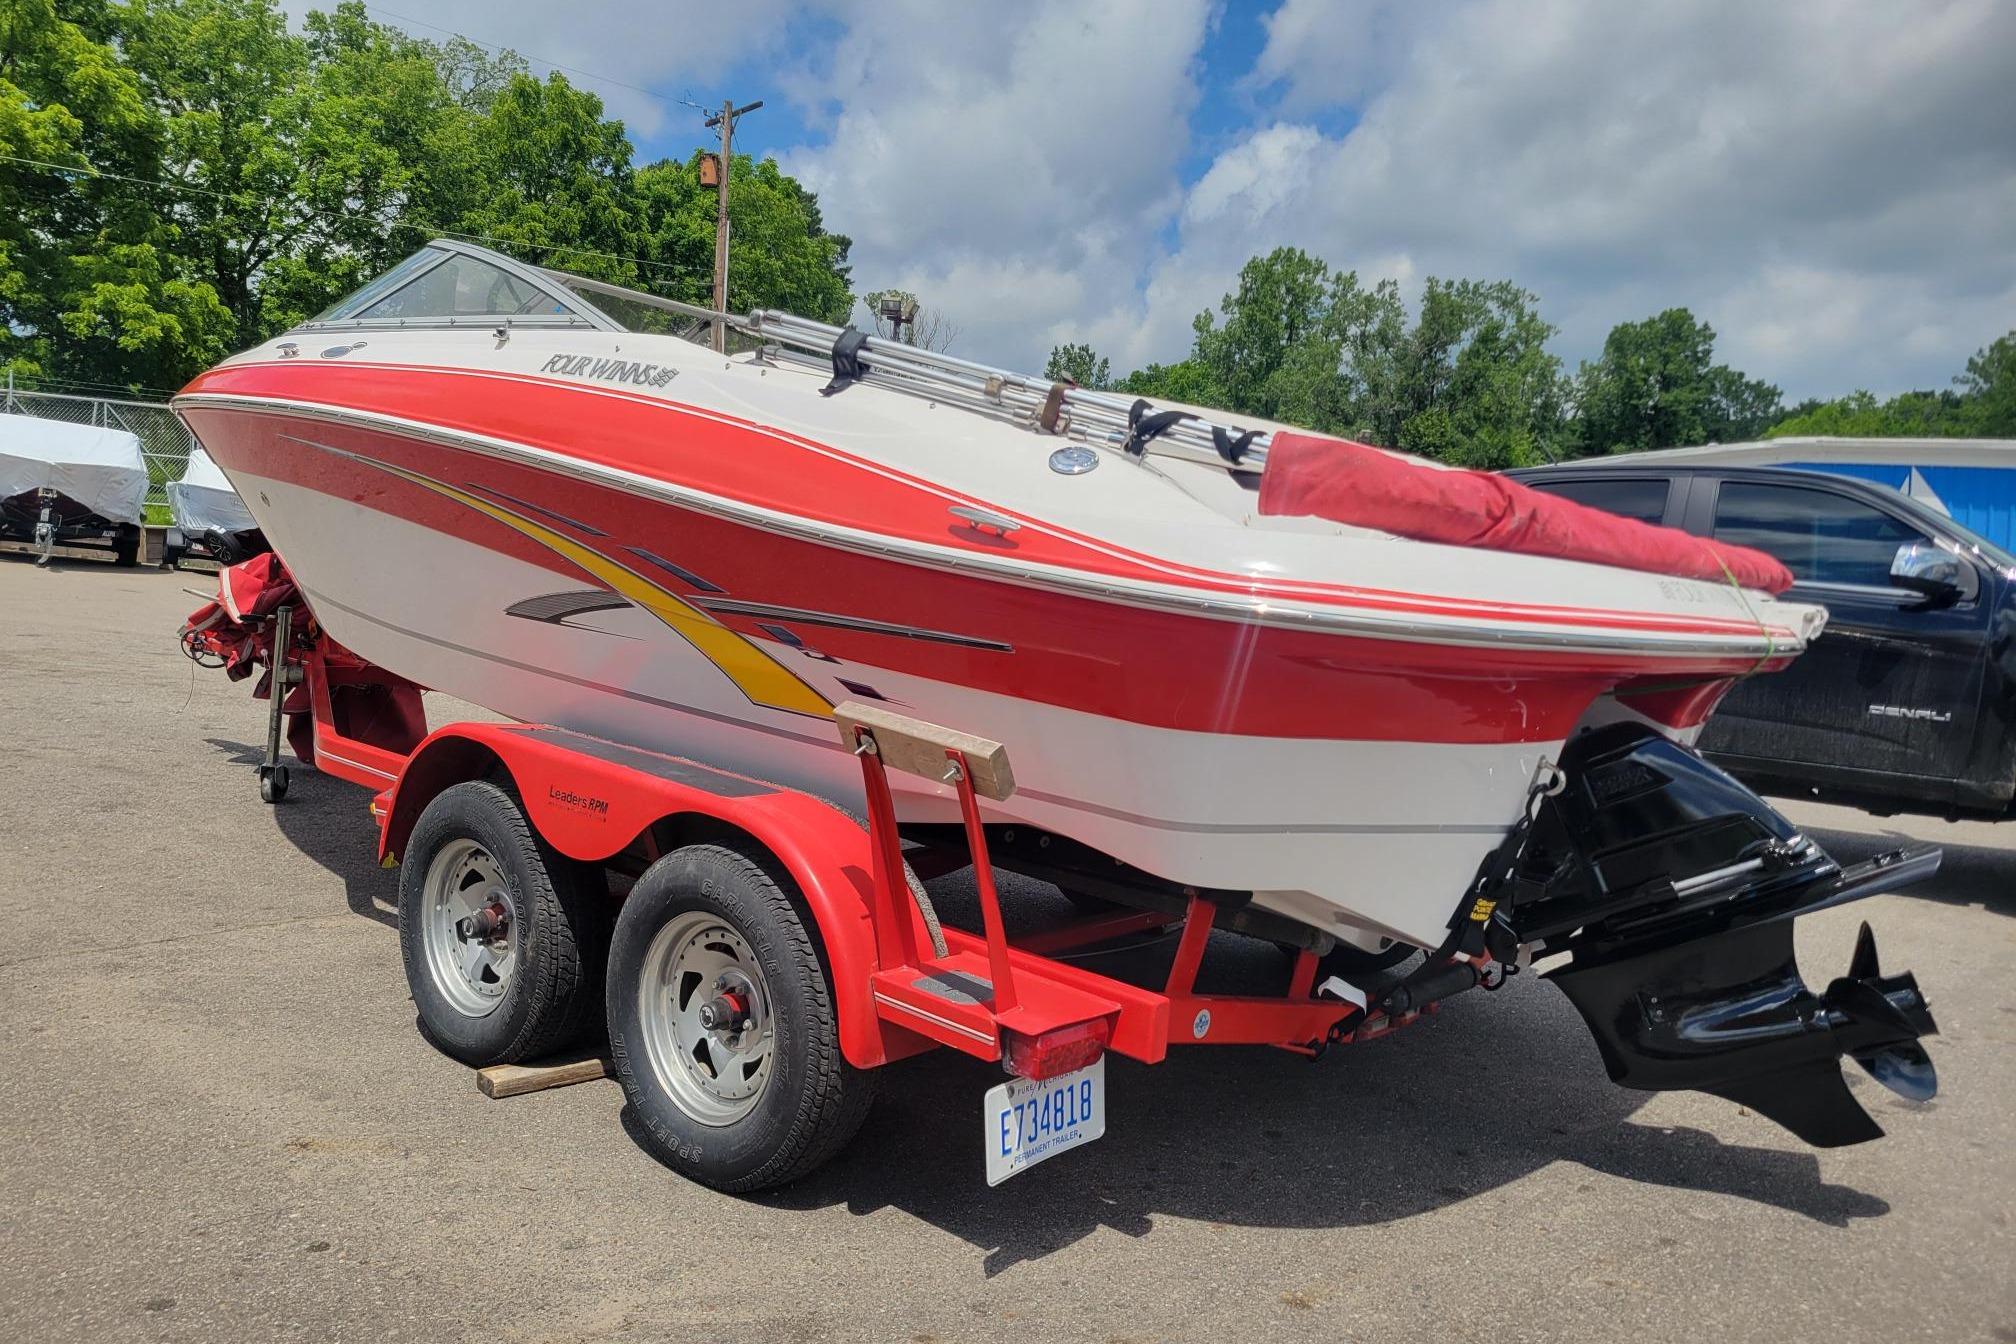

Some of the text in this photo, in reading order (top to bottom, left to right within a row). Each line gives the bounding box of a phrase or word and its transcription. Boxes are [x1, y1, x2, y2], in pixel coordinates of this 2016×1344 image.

[540, 353, 659, 385] FOUR WINNS
[1868, 704, 1952, 721] DENALI
[549, 783, 588, 809] Leaders
[588, 798, 609, 815] RPM
[700, 878, 782, 978] CARLISLE
[613, 1031, 703, 1164] SPORT TRAIL
[1000, 1079, 1091, 1157] E734818
[1014, 1129, 1079, 1165] PERMANENT TRAILER
